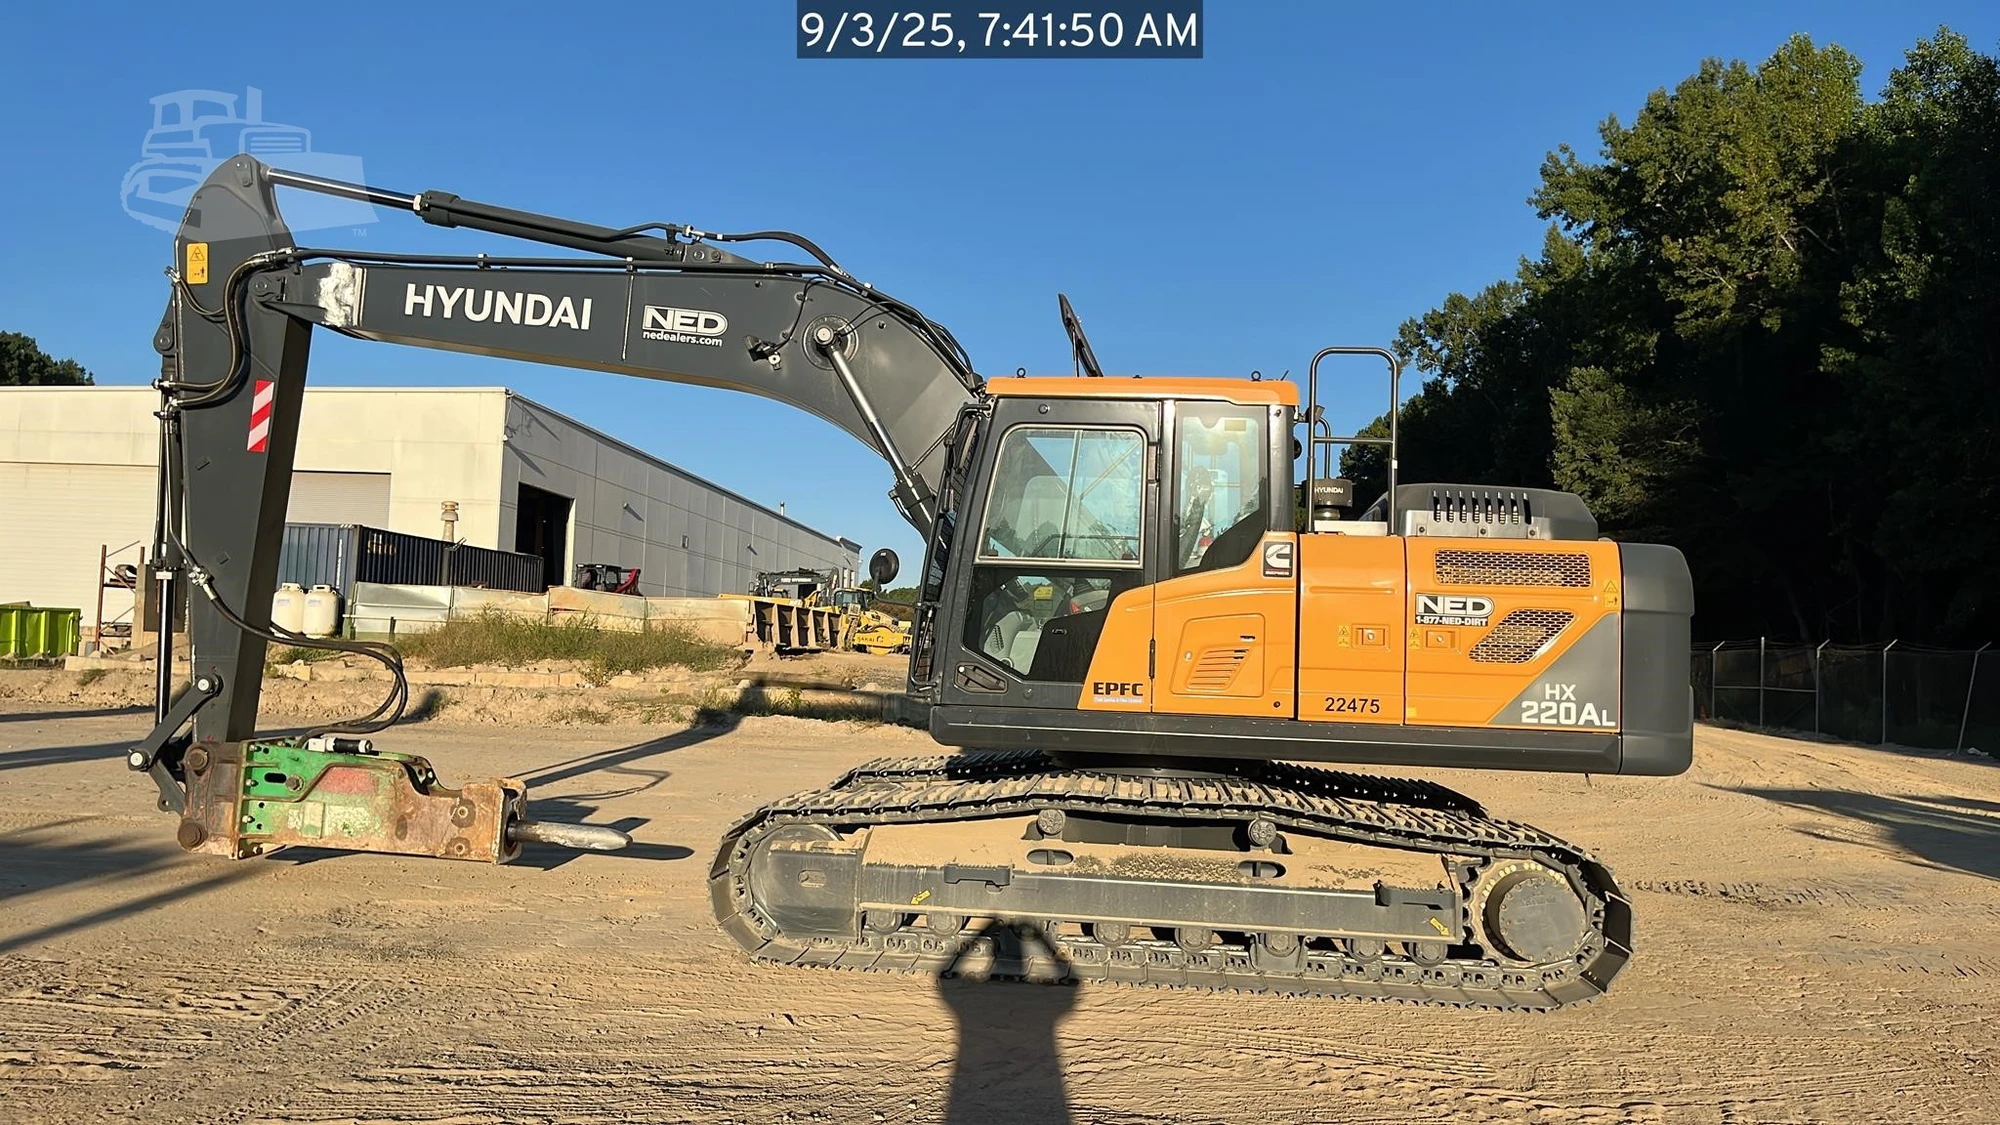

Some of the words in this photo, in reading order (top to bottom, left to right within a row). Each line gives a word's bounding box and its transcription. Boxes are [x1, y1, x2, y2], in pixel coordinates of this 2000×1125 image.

[404, 283, 593, 330] HYUNDAI
[643, 306, 728, 336] NED
[643, 330, 723, 347] nedealers.com
[1416, 594, 1494, 617] NED
[1415, 615, 1488, 627] 1-877-NED-DIRT
[1093, 682, 1144, 697] EPFC
[1545, 683, 1577, 701] HX
[1325, 697, 1380, 714] 22475
